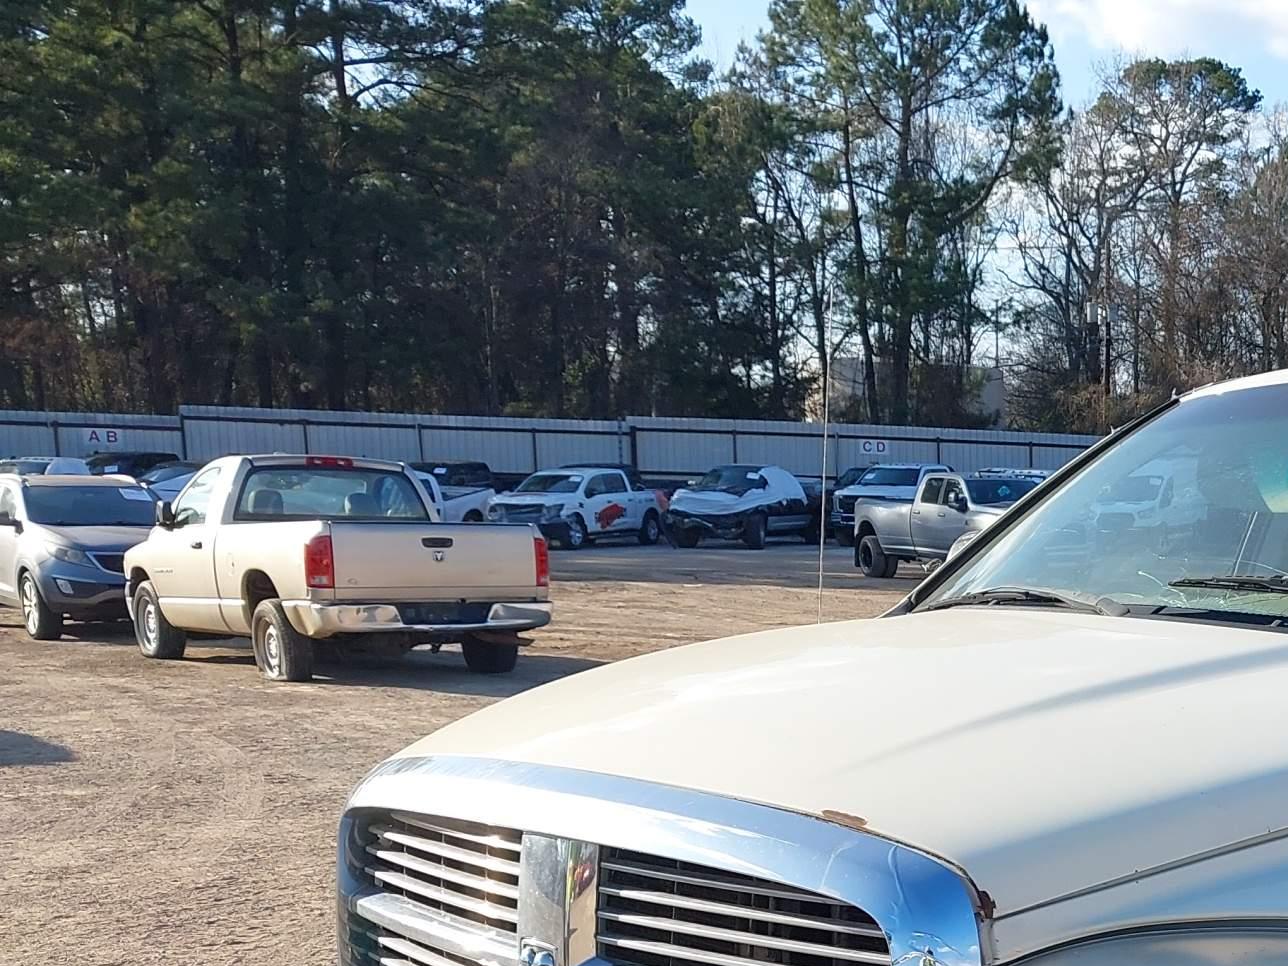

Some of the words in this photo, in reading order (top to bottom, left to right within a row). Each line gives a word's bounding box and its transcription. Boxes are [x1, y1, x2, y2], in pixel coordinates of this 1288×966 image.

[89, 430, 100, 442] A
[107, 431, 117, 443] B
[863, 441, 872, 453] C
[877, 442, 886, 453] D
